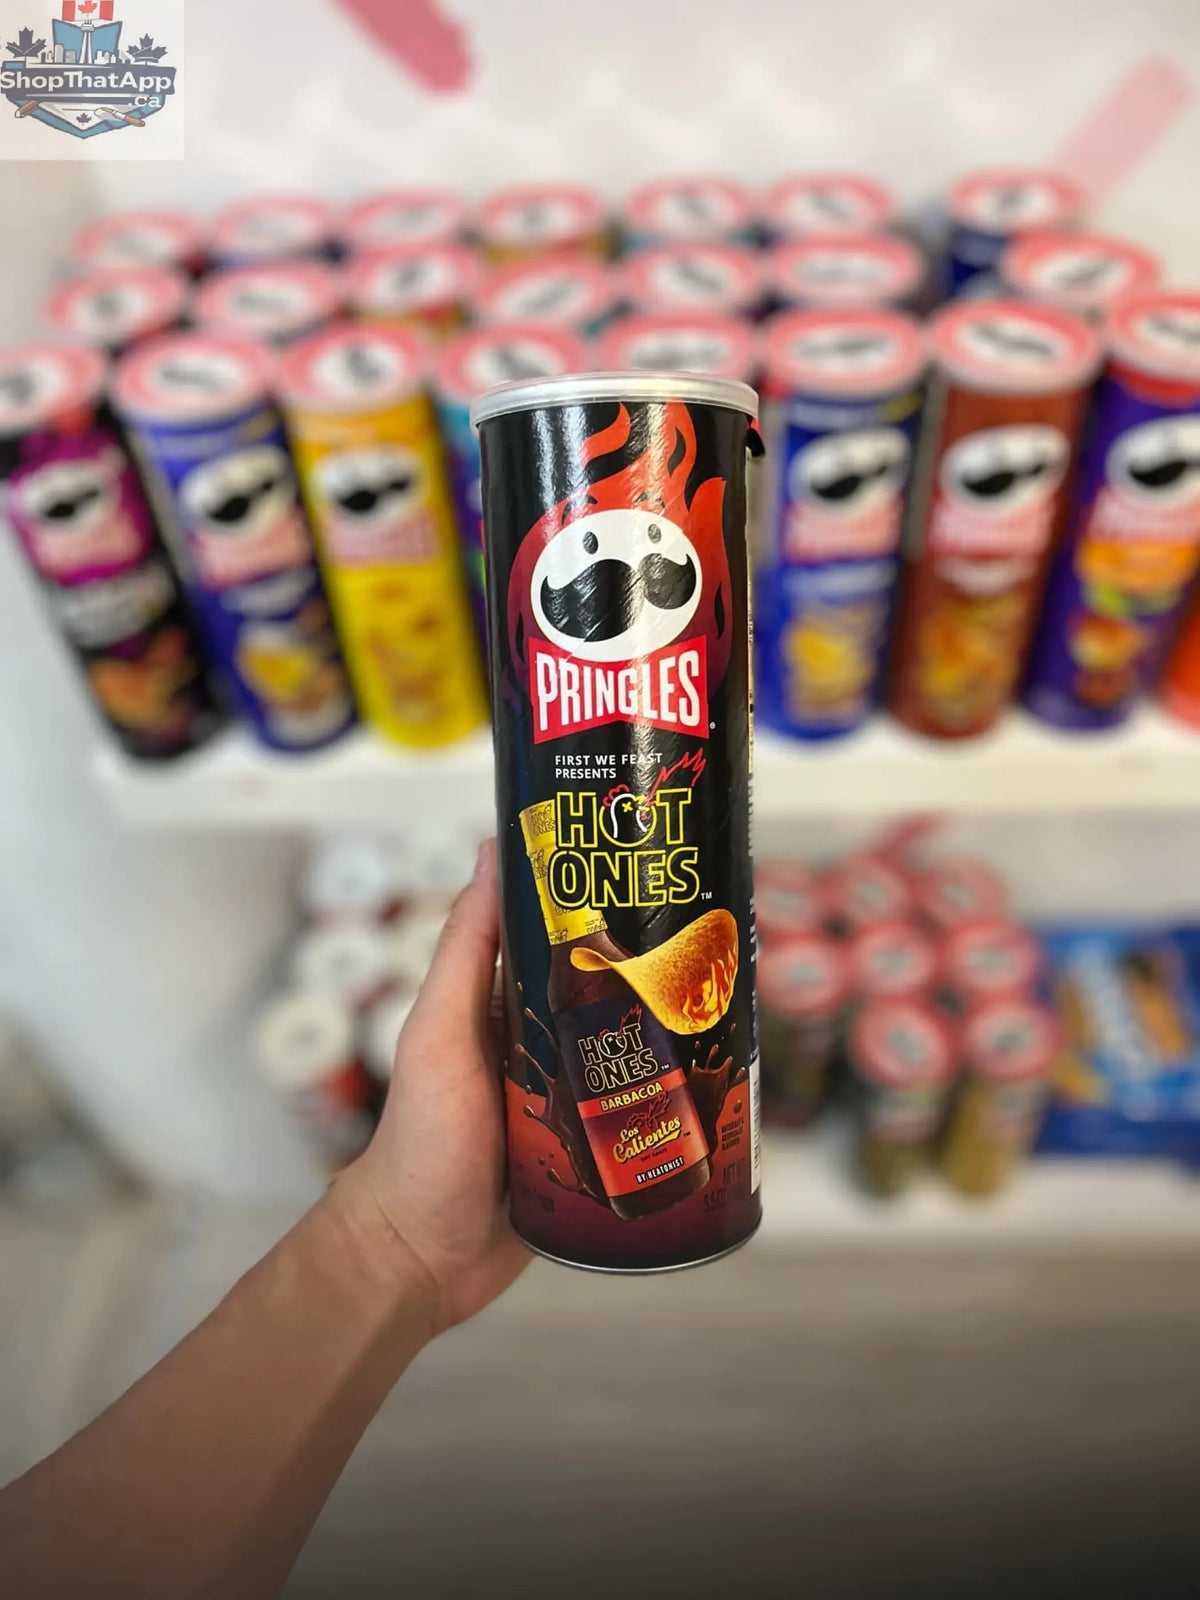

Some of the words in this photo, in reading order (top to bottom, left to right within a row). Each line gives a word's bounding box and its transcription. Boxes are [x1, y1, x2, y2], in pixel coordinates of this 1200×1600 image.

[535, 650, 700, 731] PRINGLES
[555, 754, 589, 766] FIRST
[595, 754, 616, 765] WE
[621, 752, 663, 765] FEAST
[555, 768, 617, 779] PRESENTS
[556, 788, 693, 848] HOT
[549, 847, 700, 908] ONES
[578, 1022, 643, 1066] HOT
[585, 1048, 658, 1093] ONES
[601, 1082, 663, 1111] BARBACOA
[613, 1117, 681, 1164] Calientes
[620, 1127, 639, 1143] Los
[636, 1173, 647, 1183] BY
